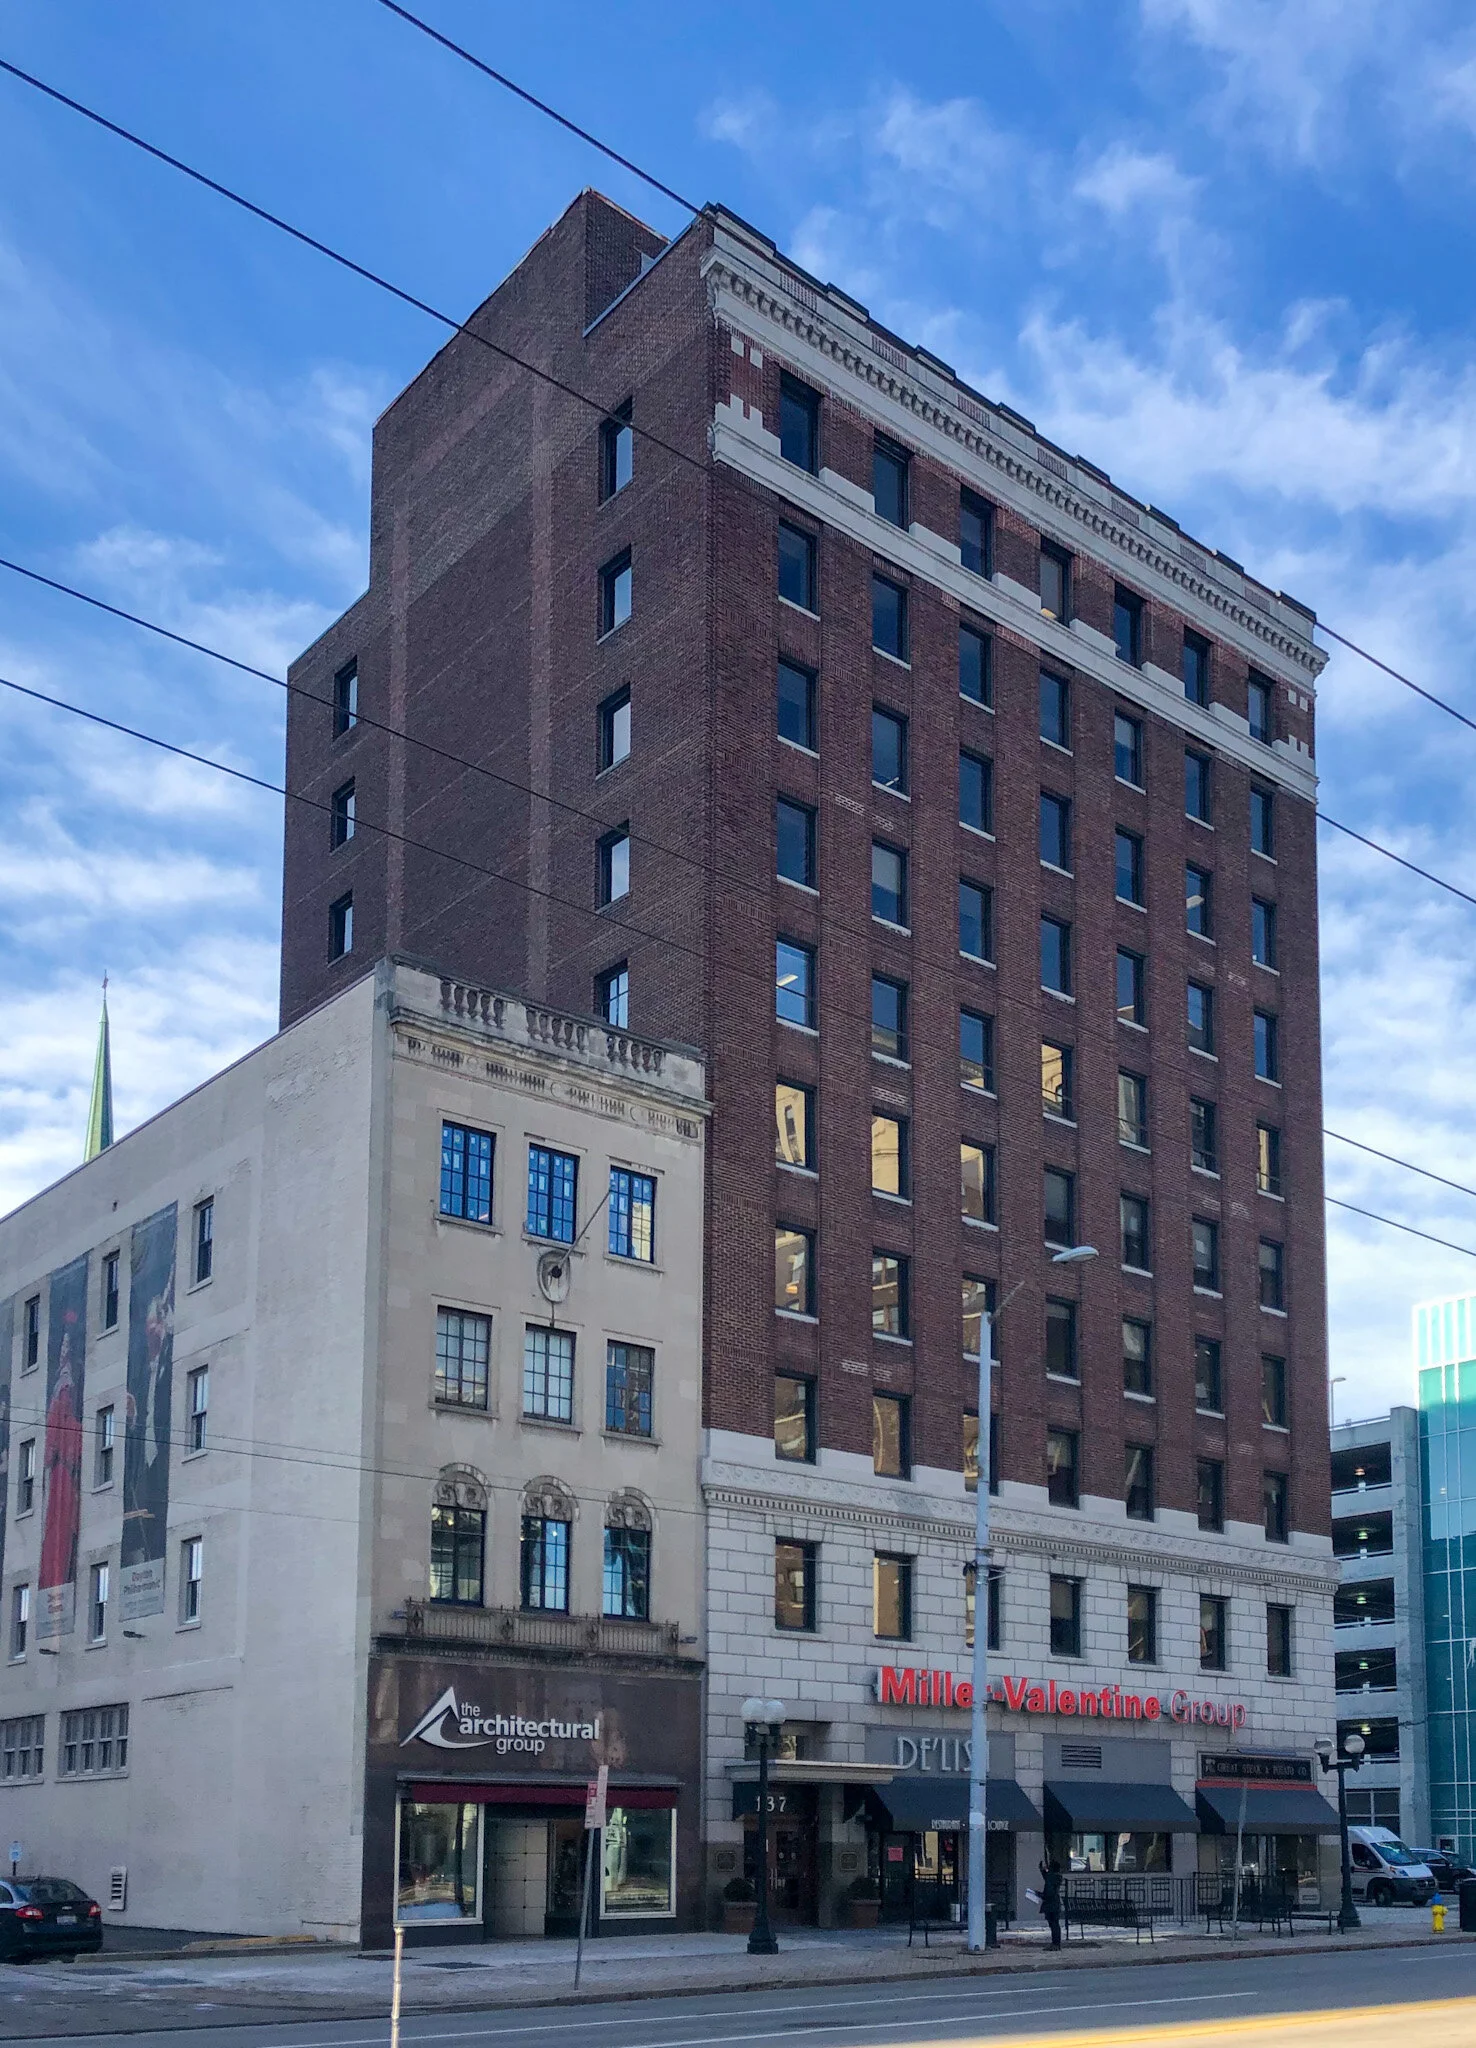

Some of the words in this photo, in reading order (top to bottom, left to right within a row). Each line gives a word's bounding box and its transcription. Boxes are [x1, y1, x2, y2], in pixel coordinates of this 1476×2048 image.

[878, 1665, 1161, 1721] Mille-Valentine
[1170, 1689, 1247, 1734] Group
[461, 1702, 481, 1717] the
[458, 1714, 600, 1740] architectural
[496, 1737, 546, 1756] group
[756, 1795, 787, 1813] 137
